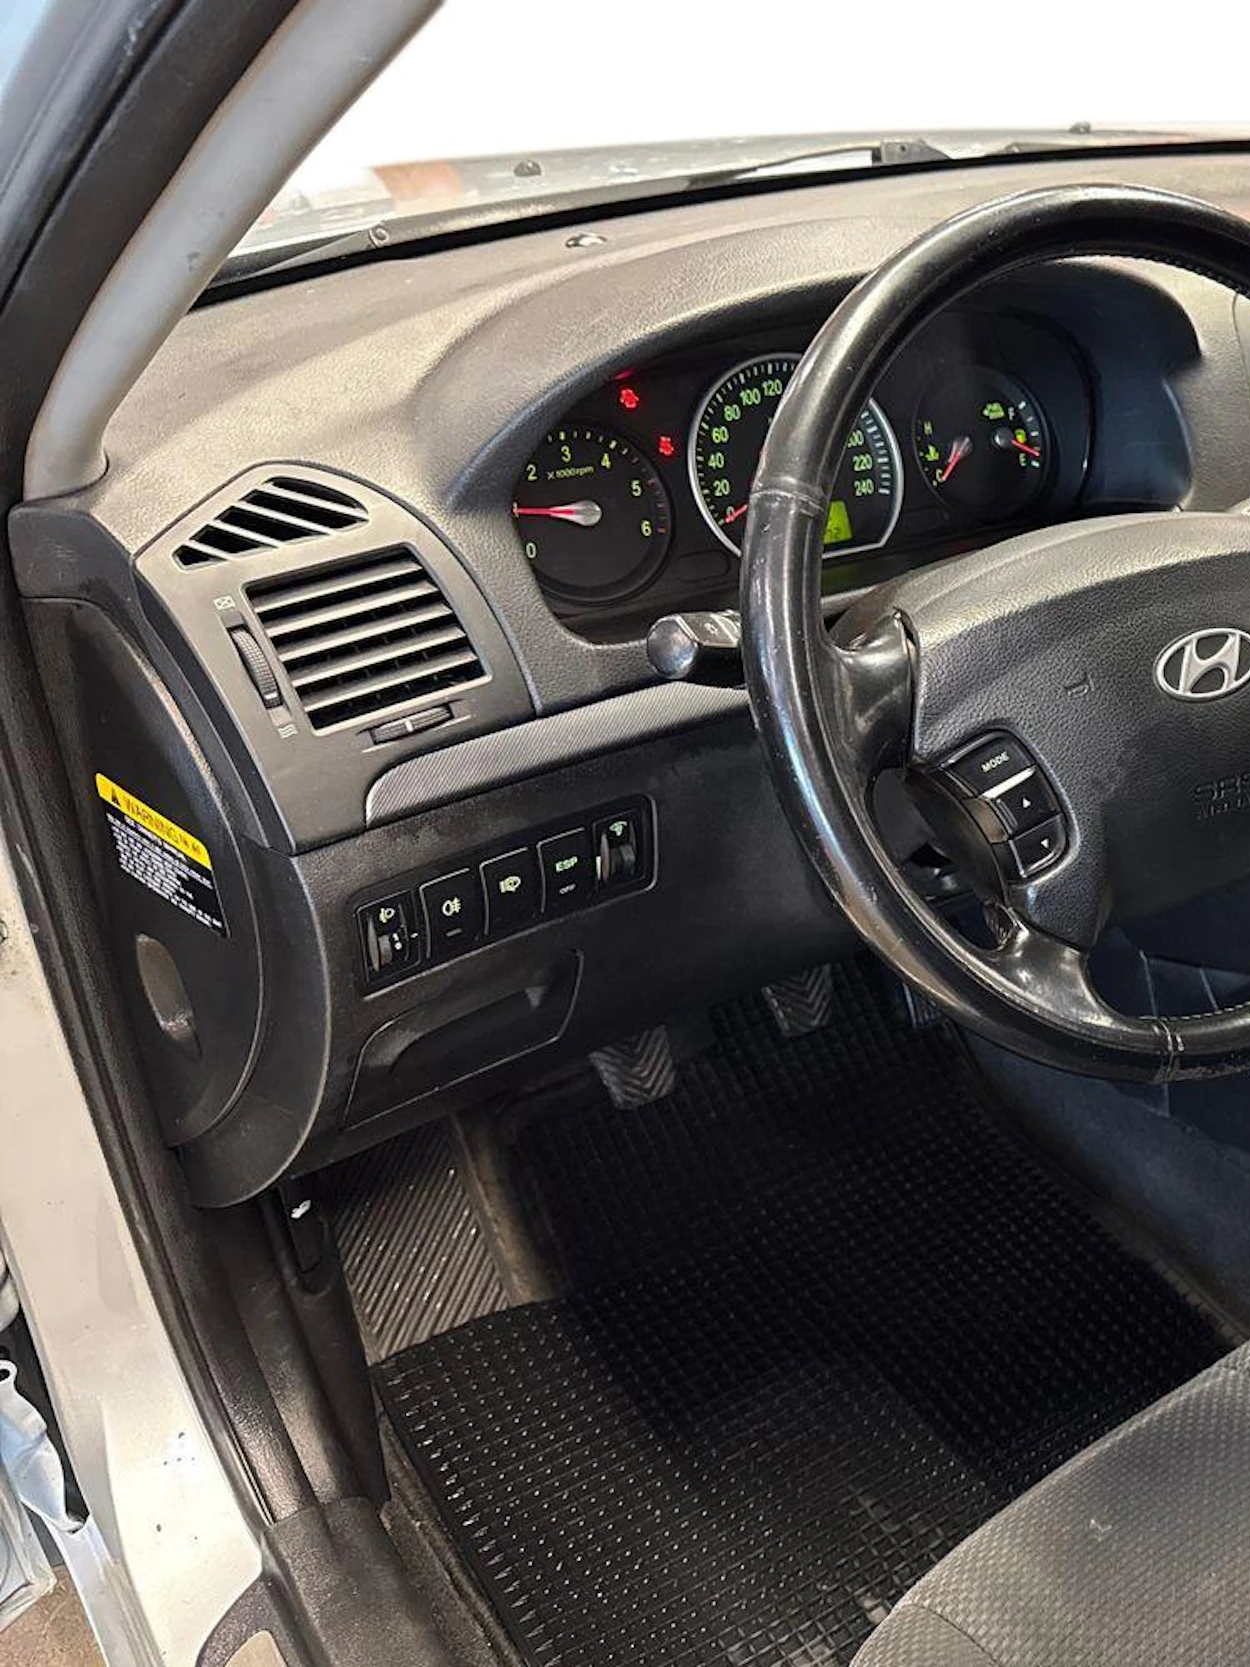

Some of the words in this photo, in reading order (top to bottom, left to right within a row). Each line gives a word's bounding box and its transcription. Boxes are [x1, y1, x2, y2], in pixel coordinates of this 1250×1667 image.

[762, 380, 782, 396] 120
[741, 388, 761, 406] 100
[724, 404, 741, 421] 80
[711, 426, 729, 443] 60
[848, 430, 865, 448] 00
[561, 445, 571, 462] 3
[601, 453, 611, 469] 4
[707, 452, 724, 469] 40
[853, 454, 873, 471] 220
[526, 463, 538, 482] 2
[631, 480, 641, 496] 5
[713, 479, 730, 496] 20
[854, 478, 874, 497] 240
[641, 520, 652, 536] 6
[525, 542, 537, 558] 0
[980, 751, 1010, 772] MODE
[555, 856, 578, 873] ESP
